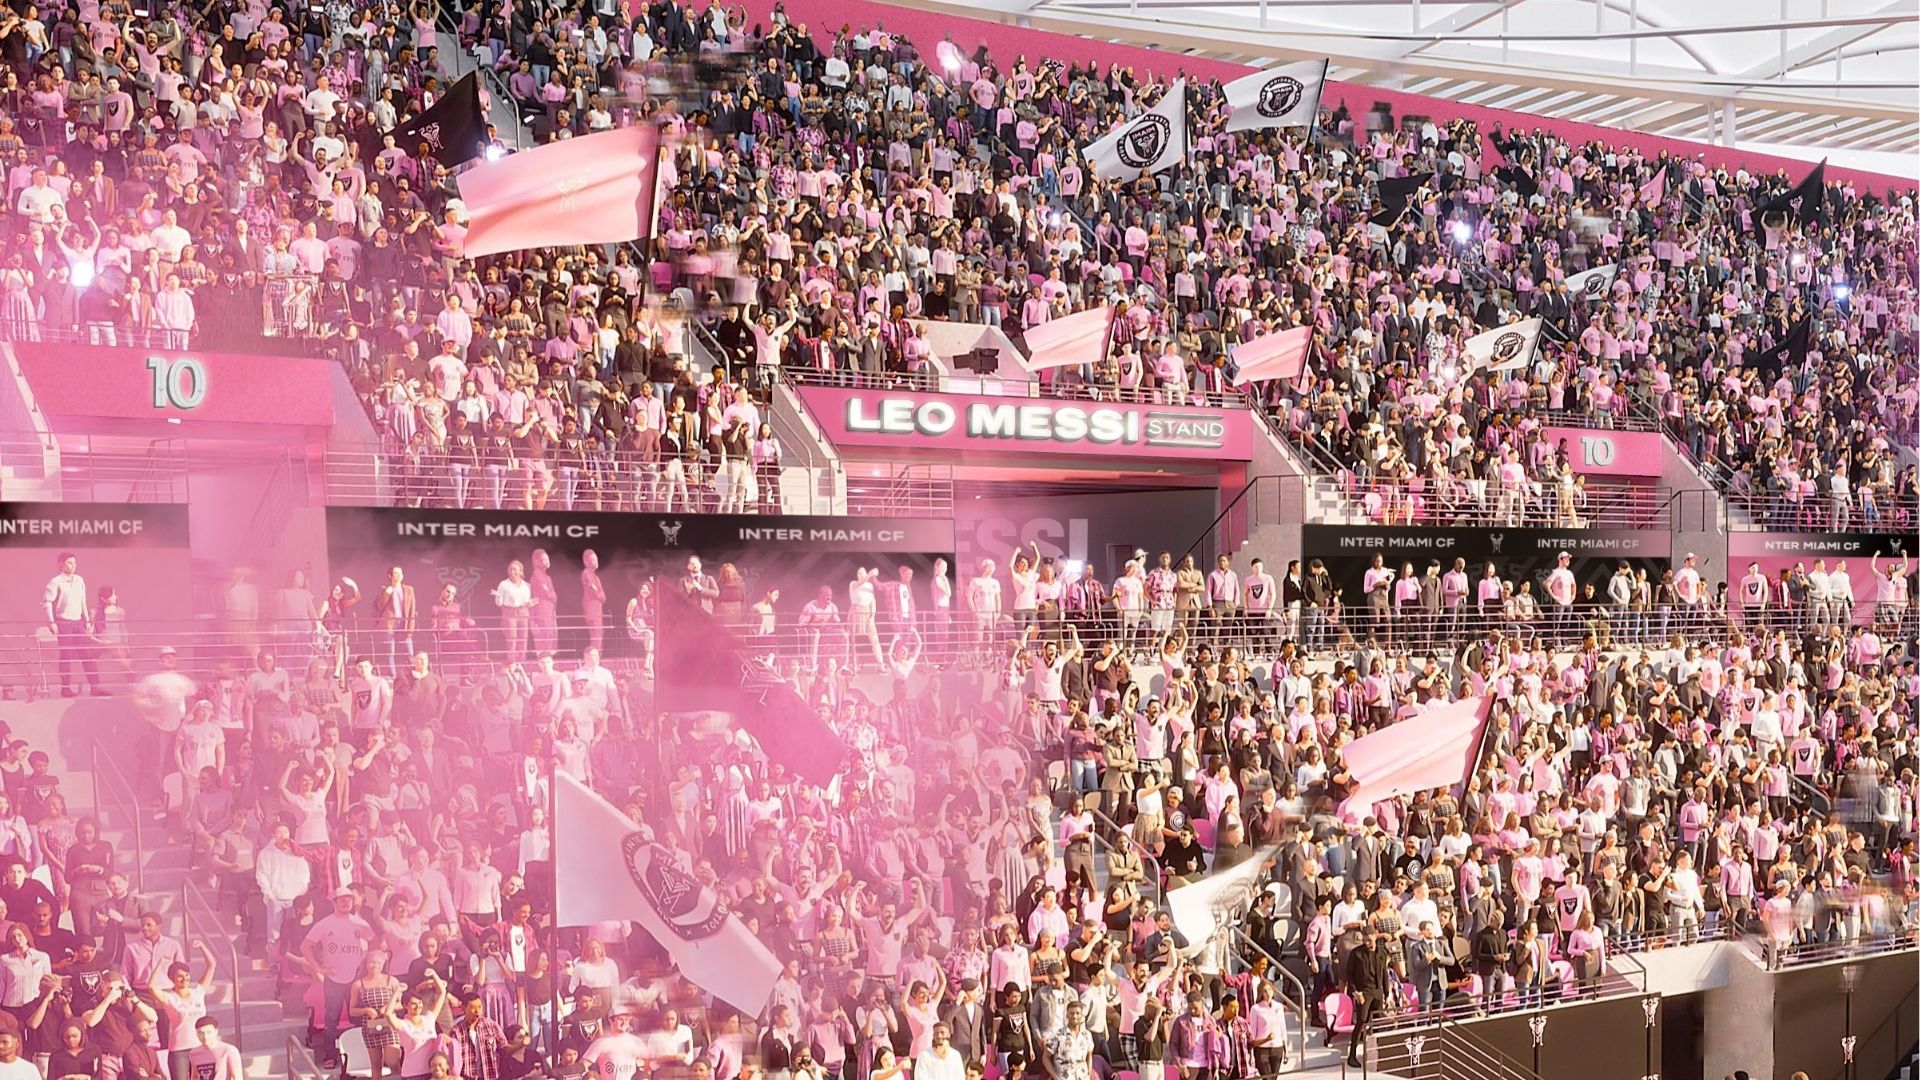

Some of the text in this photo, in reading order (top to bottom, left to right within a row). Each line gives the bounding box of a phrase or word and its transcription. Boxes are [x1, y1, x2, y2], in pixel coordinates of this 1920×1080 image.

[145, 357, 206, 410] 10
[846, 398, 1224, 445] LEO MESSI STAND
[1581, 437, 1615, 466] 10
[59, 519, 114, 535] MIAMI
[118, 519, 143, 535] CF
[398, 522, 600, 539] INTER MIAMI CF
[739, 528, 905, 542] INTER MIAMI CF
[956, 518, 1088, 577] ESSI
[1340, 536, 1455, 548] INTER MIAMI CF
[1537, 538, 1640, 549] INTER MIAMI CF
[1803, 541, 1841, 551] MIAMI
[1843, 542, 1861, 551] CF
